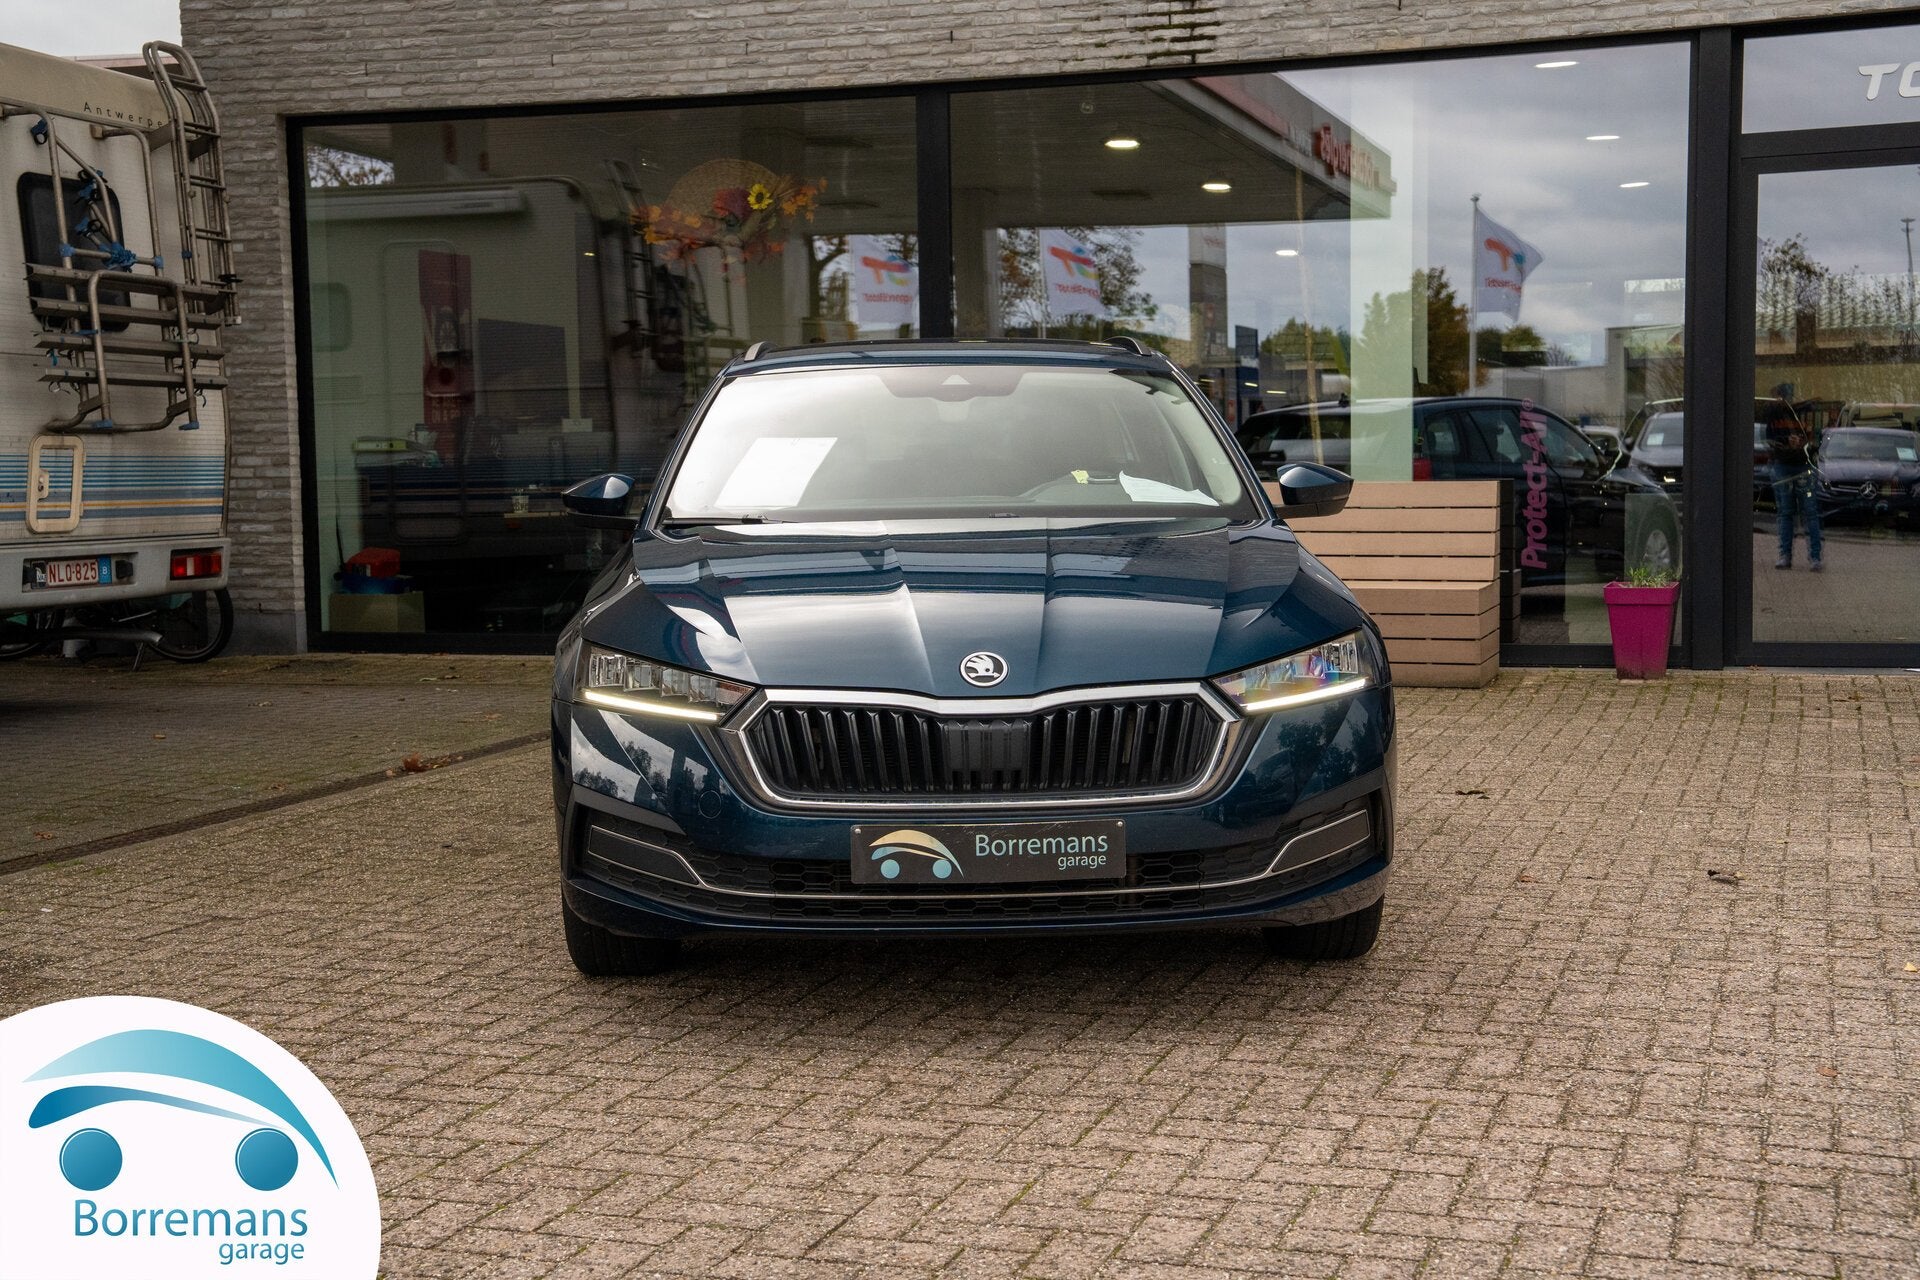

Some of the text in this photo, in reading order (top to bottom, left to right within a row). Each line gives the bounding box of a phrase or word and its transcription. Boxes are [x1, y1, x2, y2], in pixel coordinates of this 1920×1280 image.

[83, 102, 163, 127] Antwerpe
[975, 834, 1108, 857] Borremans
[1057, 854, 1107, 870] garage
